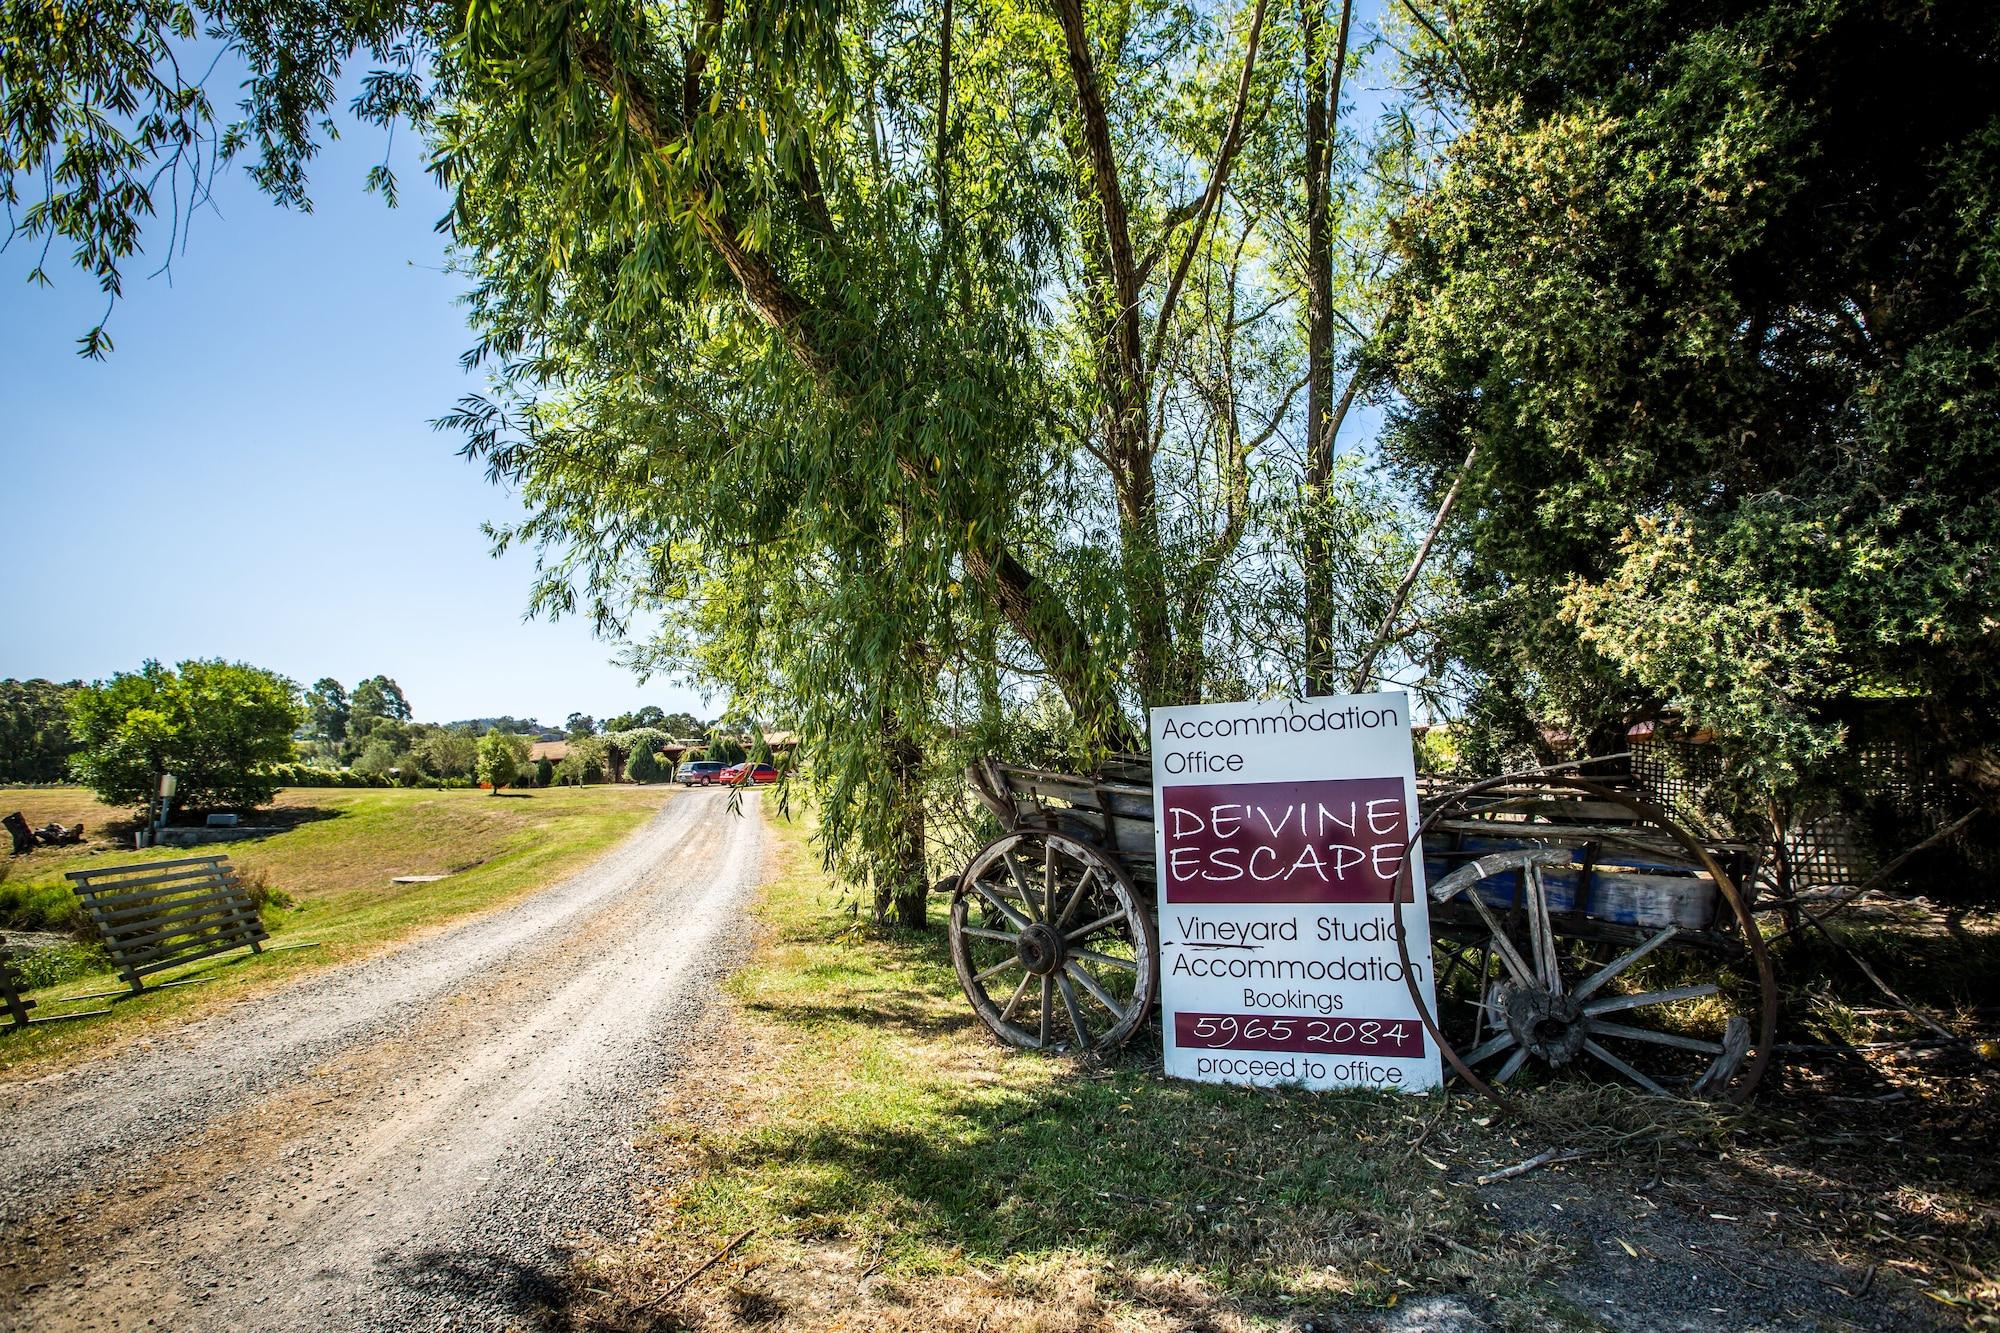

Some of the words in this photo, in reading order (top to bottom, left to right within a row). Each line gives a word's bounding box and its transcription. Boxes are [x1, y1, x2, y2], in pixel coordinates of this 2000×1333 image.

[1162, 706, 1398, 740] Accommodation
[1164, 751, 1244, 774] Office
[1169, 799, 1400, 840] DE'VINE
[1169, 843, 1405, 882] ESCAPE
[1177, 916, 1298, 945] Vineyard
[1172, 953, 1423, 982] Accommodation
[1243, 988, 1343, 1014] Bookings
[1193, 1017, 1298, 1048] 5965
[1306, 1021, 1410, 1047] 2084
[1197, 1057, 1295, 1077] proceed
[1302, 1058, 1326, 1078] to
[1334, 1061, 1403, 1084] office
